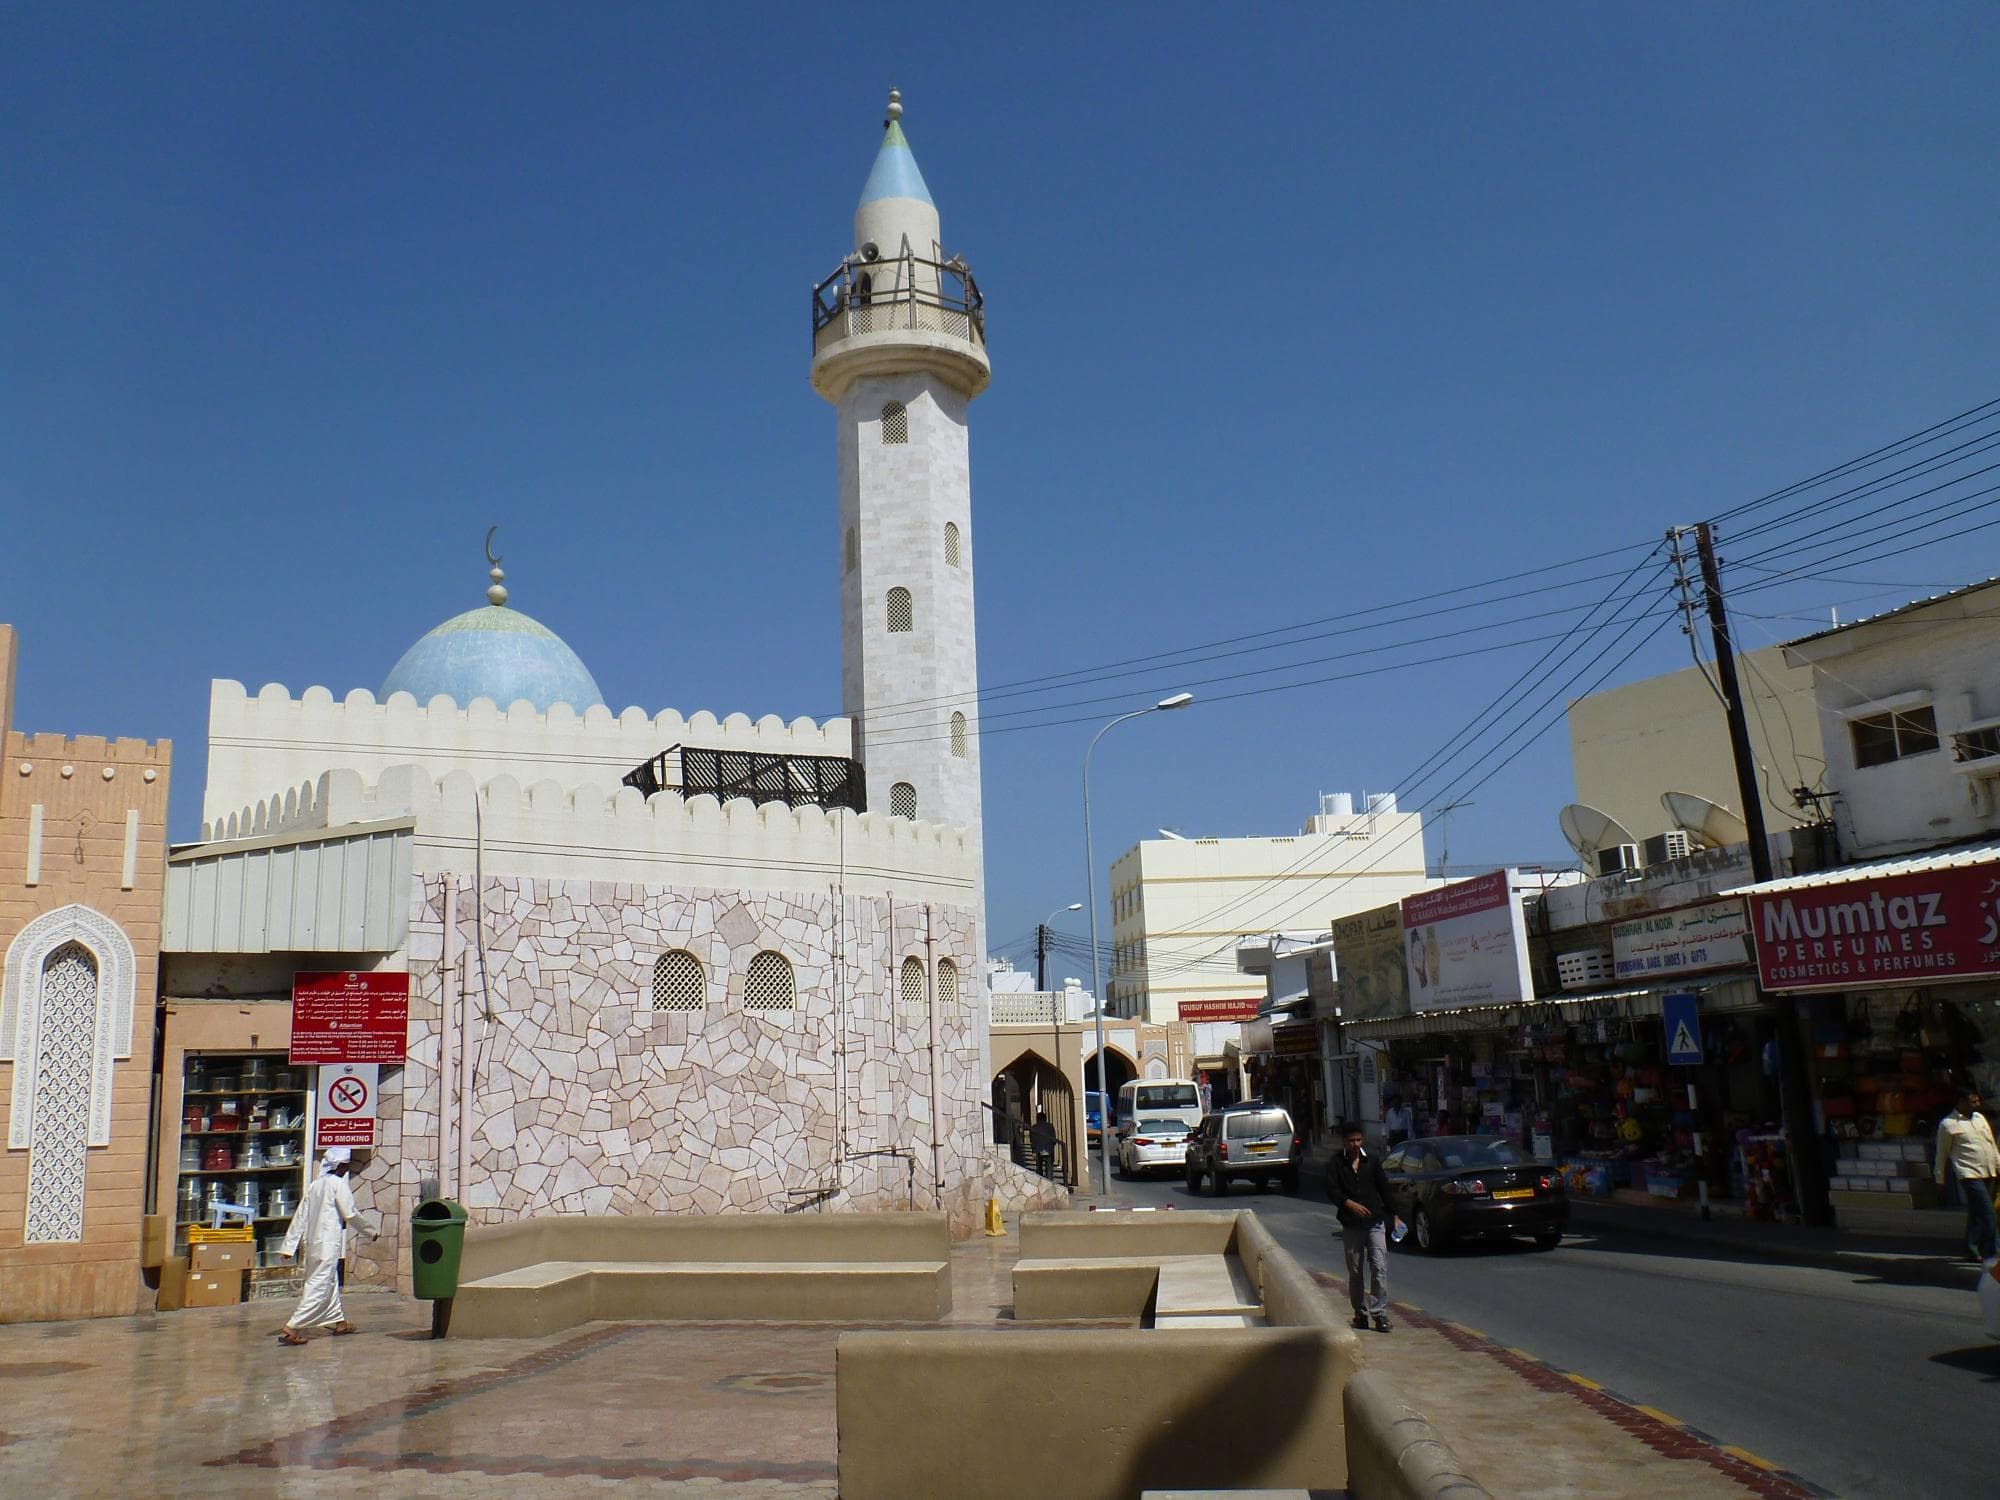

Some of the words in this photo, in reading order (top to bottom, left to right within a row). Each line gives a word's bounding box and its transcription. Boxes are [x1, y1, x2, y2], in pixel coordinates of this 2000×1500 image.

[1763, 890, 1947, 943] Mumtaz
[1776, 931, 1934, 962] PERFUMES
[1770, 961, 1850, 980] COSMETICS
[1857, 960, 1867, 974] &
[1873, 952, 1957, 972] PERFUMES
[322, 1120, 348, 1130] التدخين
[348, 1120, 370, 1130] ممنوع
[321, 1135, 334, 1143] NO
[334, 1135, 370, 1143] SMOKING
